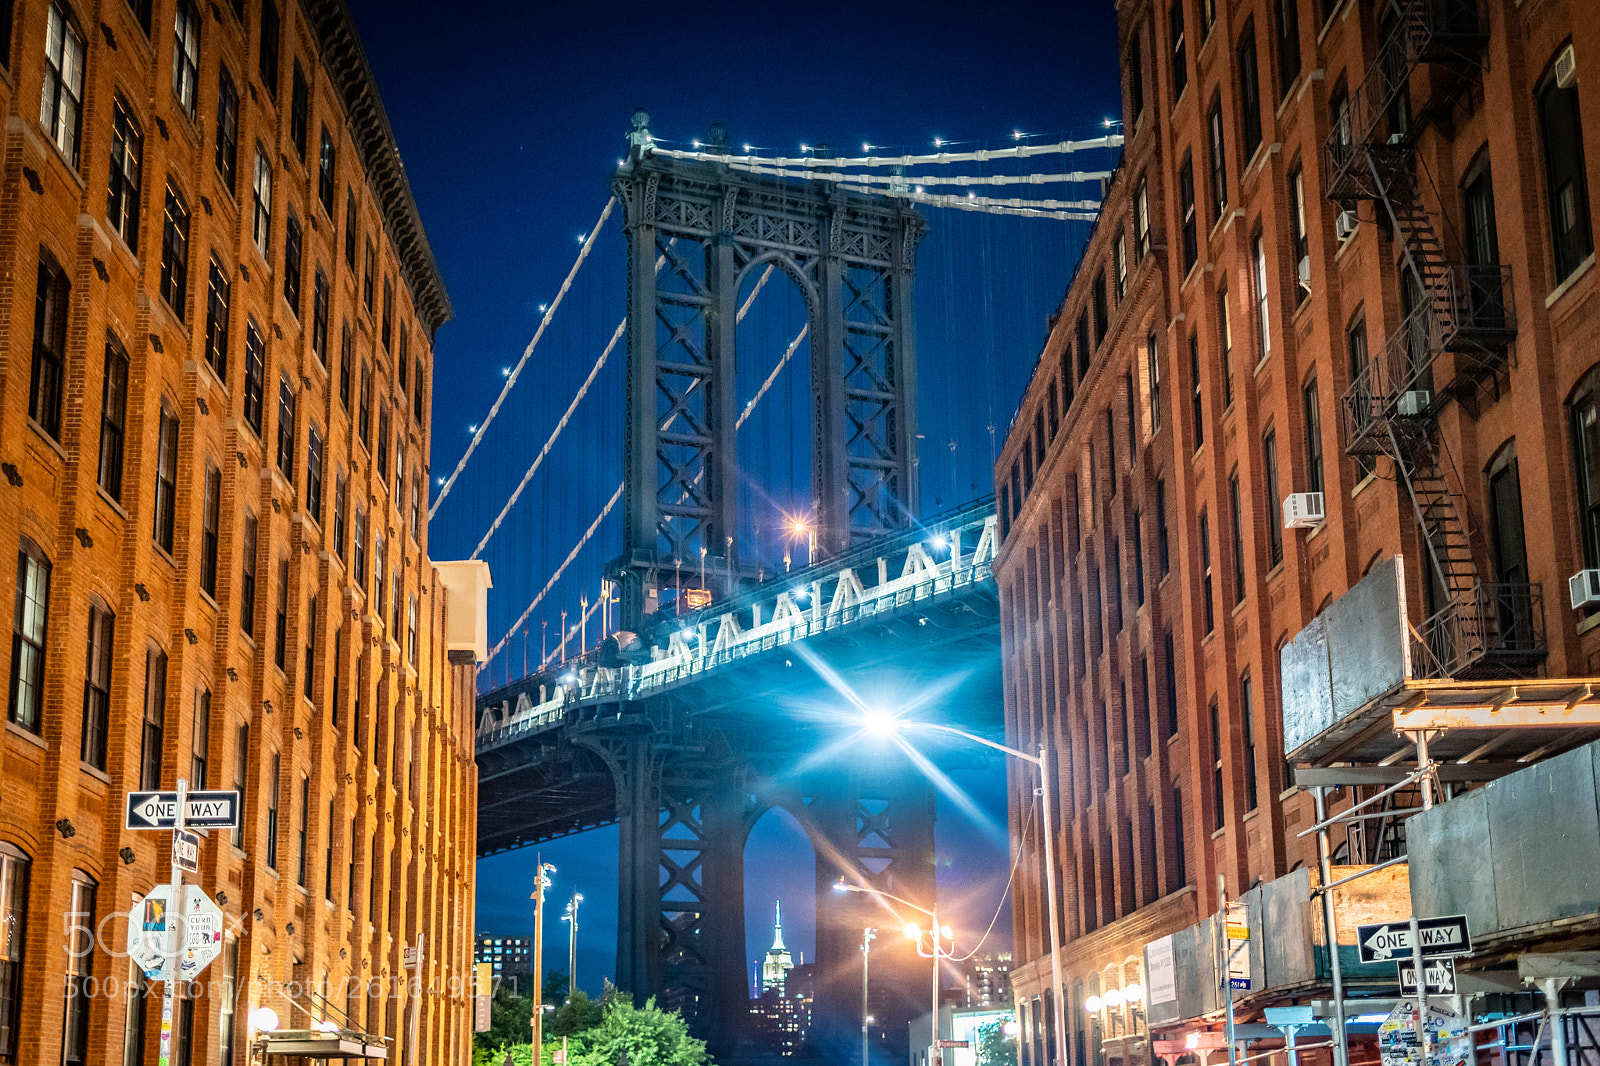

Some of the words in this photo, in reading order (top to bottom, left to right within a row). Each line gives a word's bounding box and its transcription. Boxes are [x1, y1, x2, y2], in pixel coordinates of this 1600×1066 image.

[145, 803, 175, 817] ONE
[190, 802, 223, 817] WAY
[1376, 933, 1407, 949] ONE
[1421, 928, 1454, 945] WAY
[1406, 970, 1419, 985] ON
[1428, 970, 1446, 985] WAY
